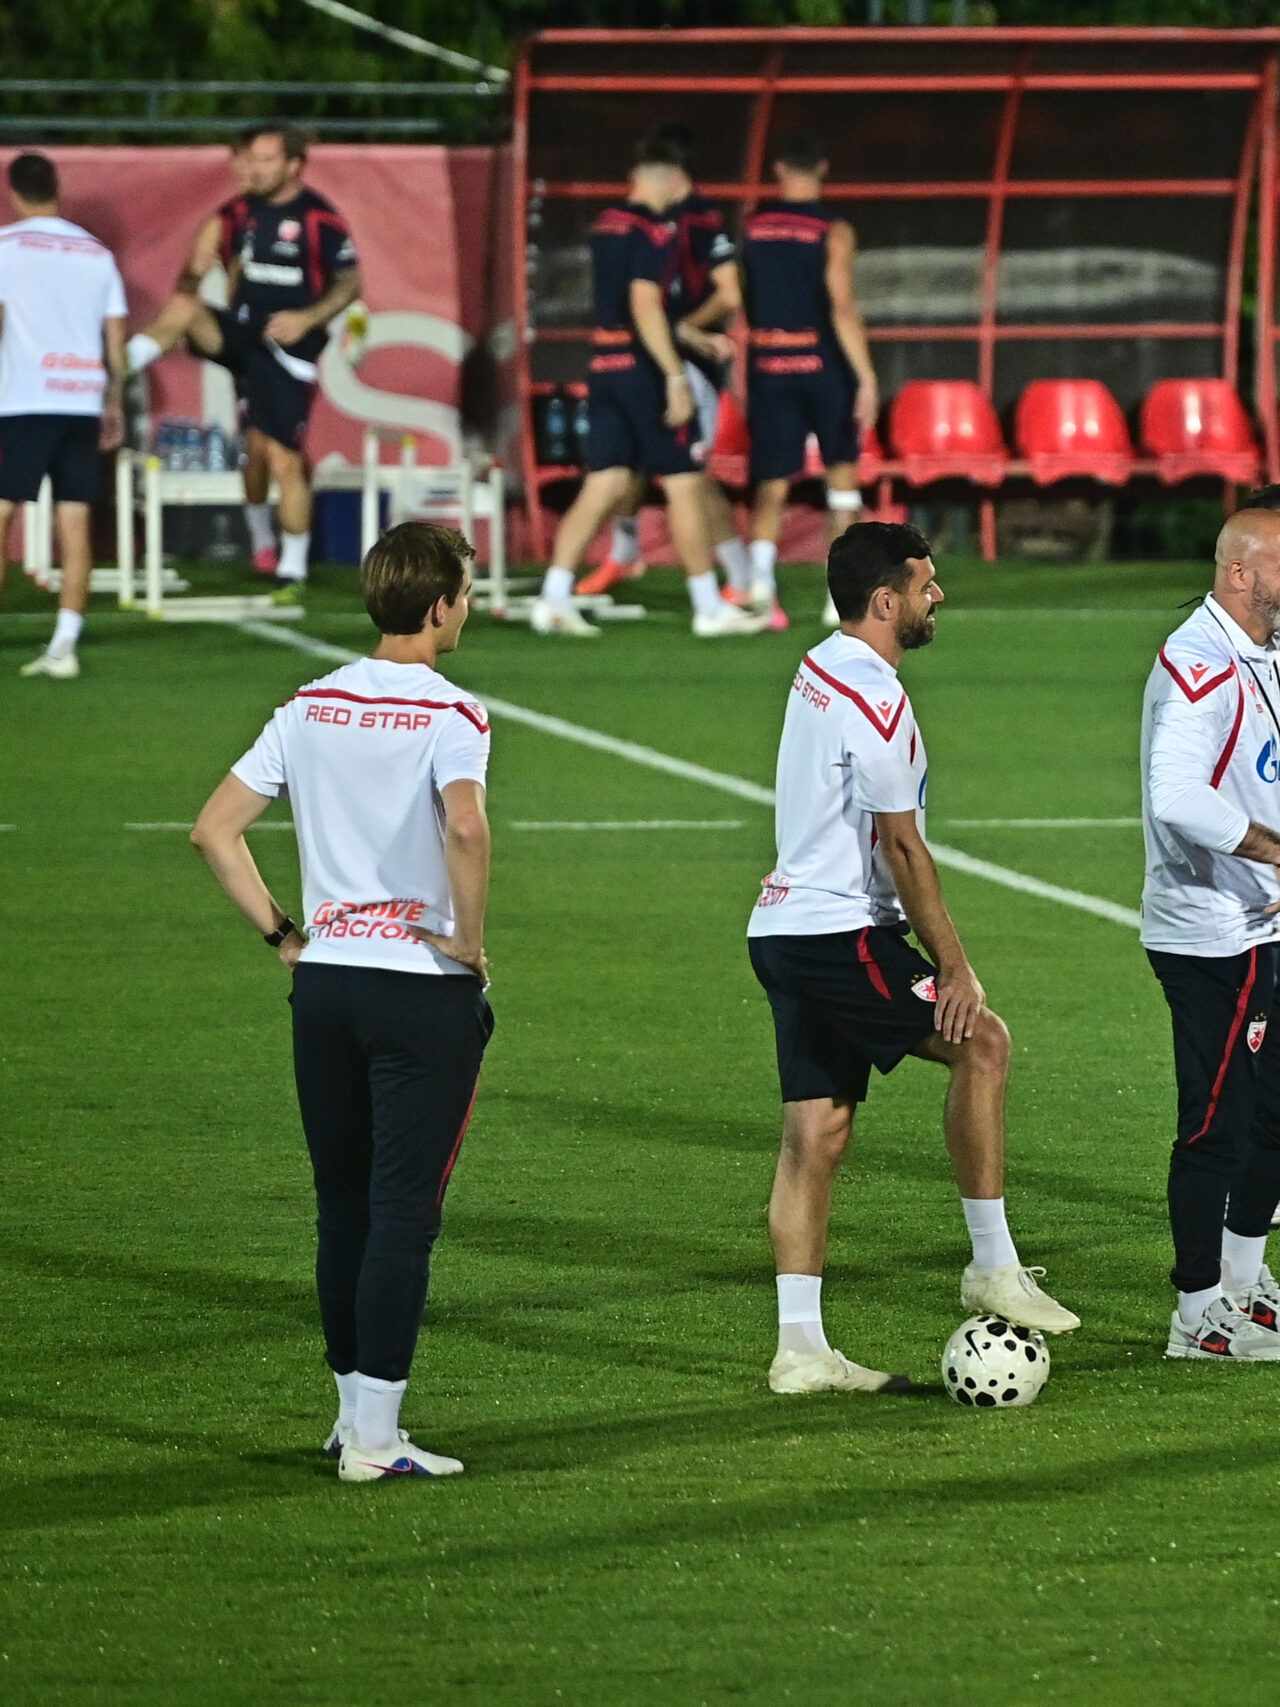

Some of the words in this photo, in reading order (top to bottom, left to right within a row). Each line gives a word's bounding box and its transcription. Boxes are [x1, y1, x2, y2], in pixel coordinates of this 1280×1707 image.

[802, 681, 831, 712] STAR
[305, 704, 352, 726] RED
[359, 711, 432, 731] STAR
